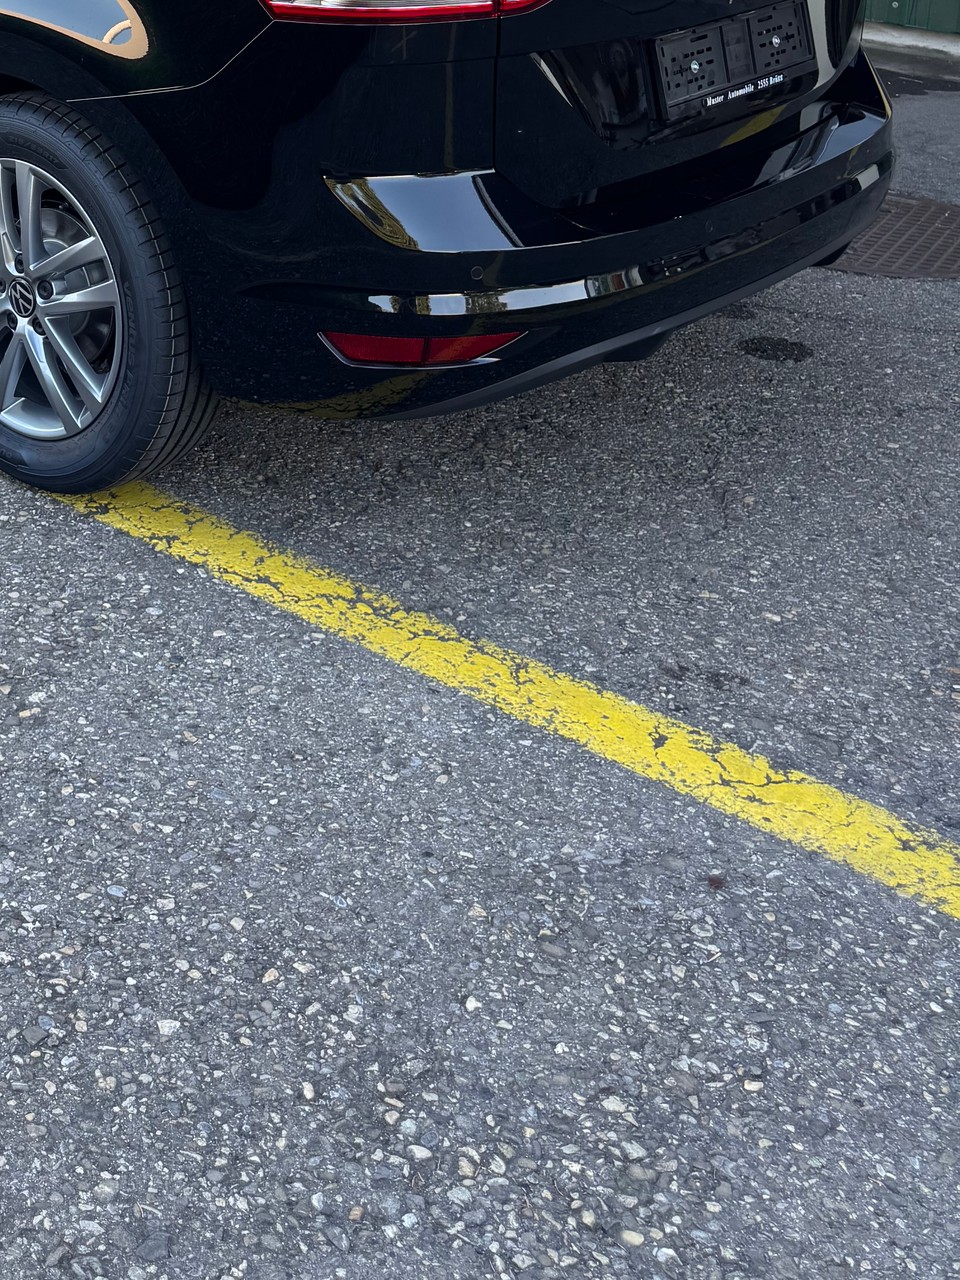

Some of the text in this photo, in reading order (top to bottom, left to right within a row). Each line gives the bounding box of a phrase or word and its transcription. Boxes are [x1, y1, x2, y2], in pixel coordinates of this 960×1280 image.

[706, 94, 724, 107] Muster
[727, 83, 755, 100] Automobile
[757, 77, 769, 89] 2555
